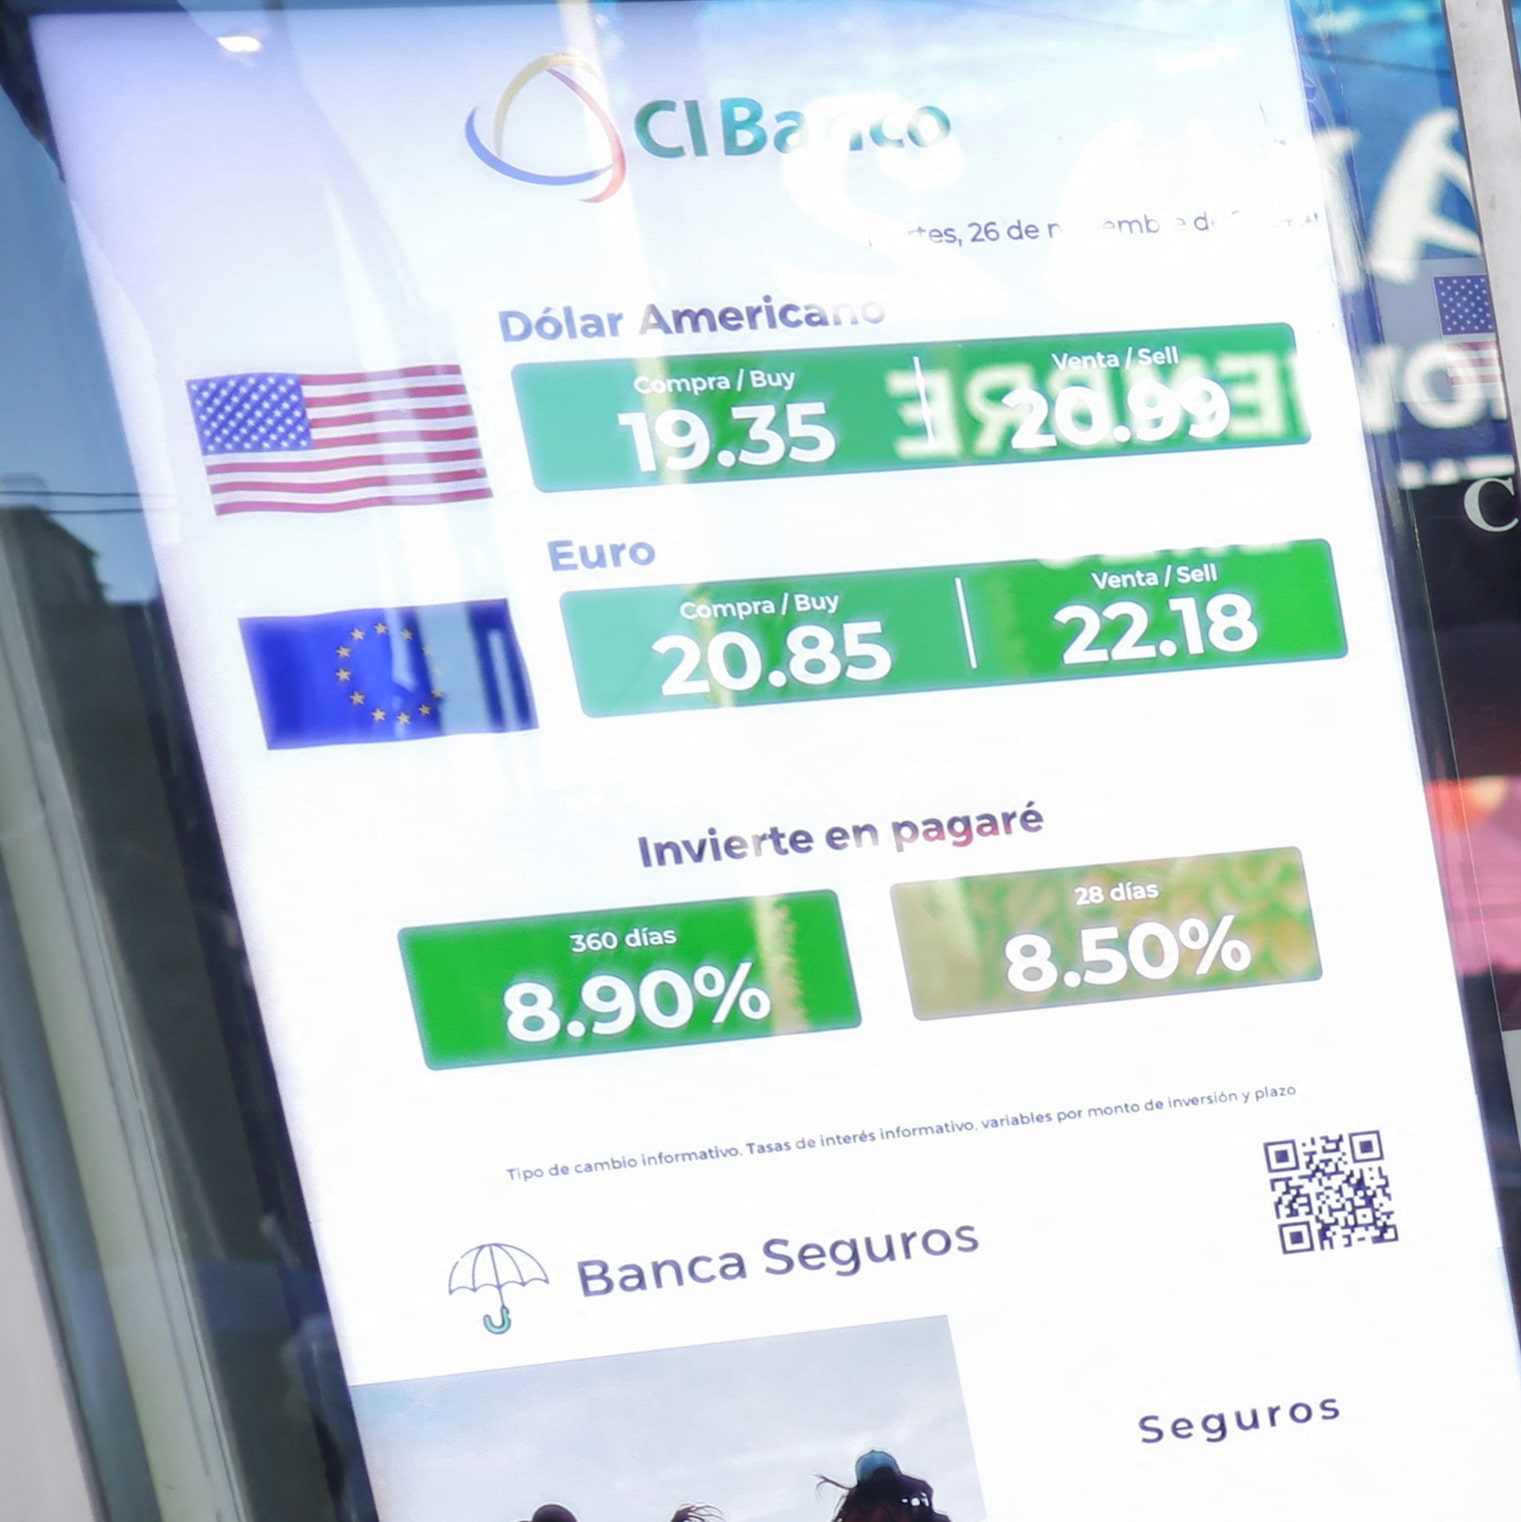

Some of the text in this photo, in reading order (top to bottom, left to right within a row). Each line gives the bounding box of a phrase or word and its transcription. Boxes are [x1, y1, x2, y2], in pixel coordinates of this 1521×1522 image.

[634, 97, 951, 158] CIBaco
[968, 221, 1000, 242] 26
[1006, 219, 1040, 240] de
[498, 294, 886, 342] Dólar Americano
[633, 371, 731, 396] Compra
[750, 369, 796, 392] Buy
[1052, 350, 1120, 372] Venta
[1137, 346, 1180, 367] Sell
[617, 401, 837, 473] 19.35
[1001, 376, 1231, 450] 20.99
[547, 539, 656, 572] Euro
[1091, 571, 1159, 590] Venta
[1176, 563, 1218, 585] Sell
[679, 599, 776, 621] Compra
[793, 593, 840, 615] Buy
[1053, 592, 1259, 665] 22.18
[651, 620, 892, 696] 20.85
[638, 800, 1045, 868] Invierte en pagaré
[1074, 880, 1159, 906] 28 días
[569, 926, 678, 953] 360 días
[1004, 914, 1253, 993] 8.50%
[502, 960, 771, 1043] 8.90%
[506, 1166, 544, 1183] Tipo
[548, 1162, 570, 1177] de
[574, 1155, 637, 1175] cambio
[641, 1146, 744, 1167] informativo.
[745, 1138, 791, 1156] Tasas
[795, 1136, 817, 1151] de
[819, 1130, 876, 1148] interés
[981, 1110, 1053, 1129] variables
[1057, 1108, 1083, 1124] por
[1087, 1101, 1141, 1118] monto
[1144, 1098, 1164, 1111] de
[1168, 1090, 1238, 1109] inversión
[1242, 1091, 1251, 1103] y
[1255, 1085, 1297, 1102] plazo
[576, 1224, 980, 1298] Banca Seguros
[1138, 1397, 1341, 1444] Seguros
